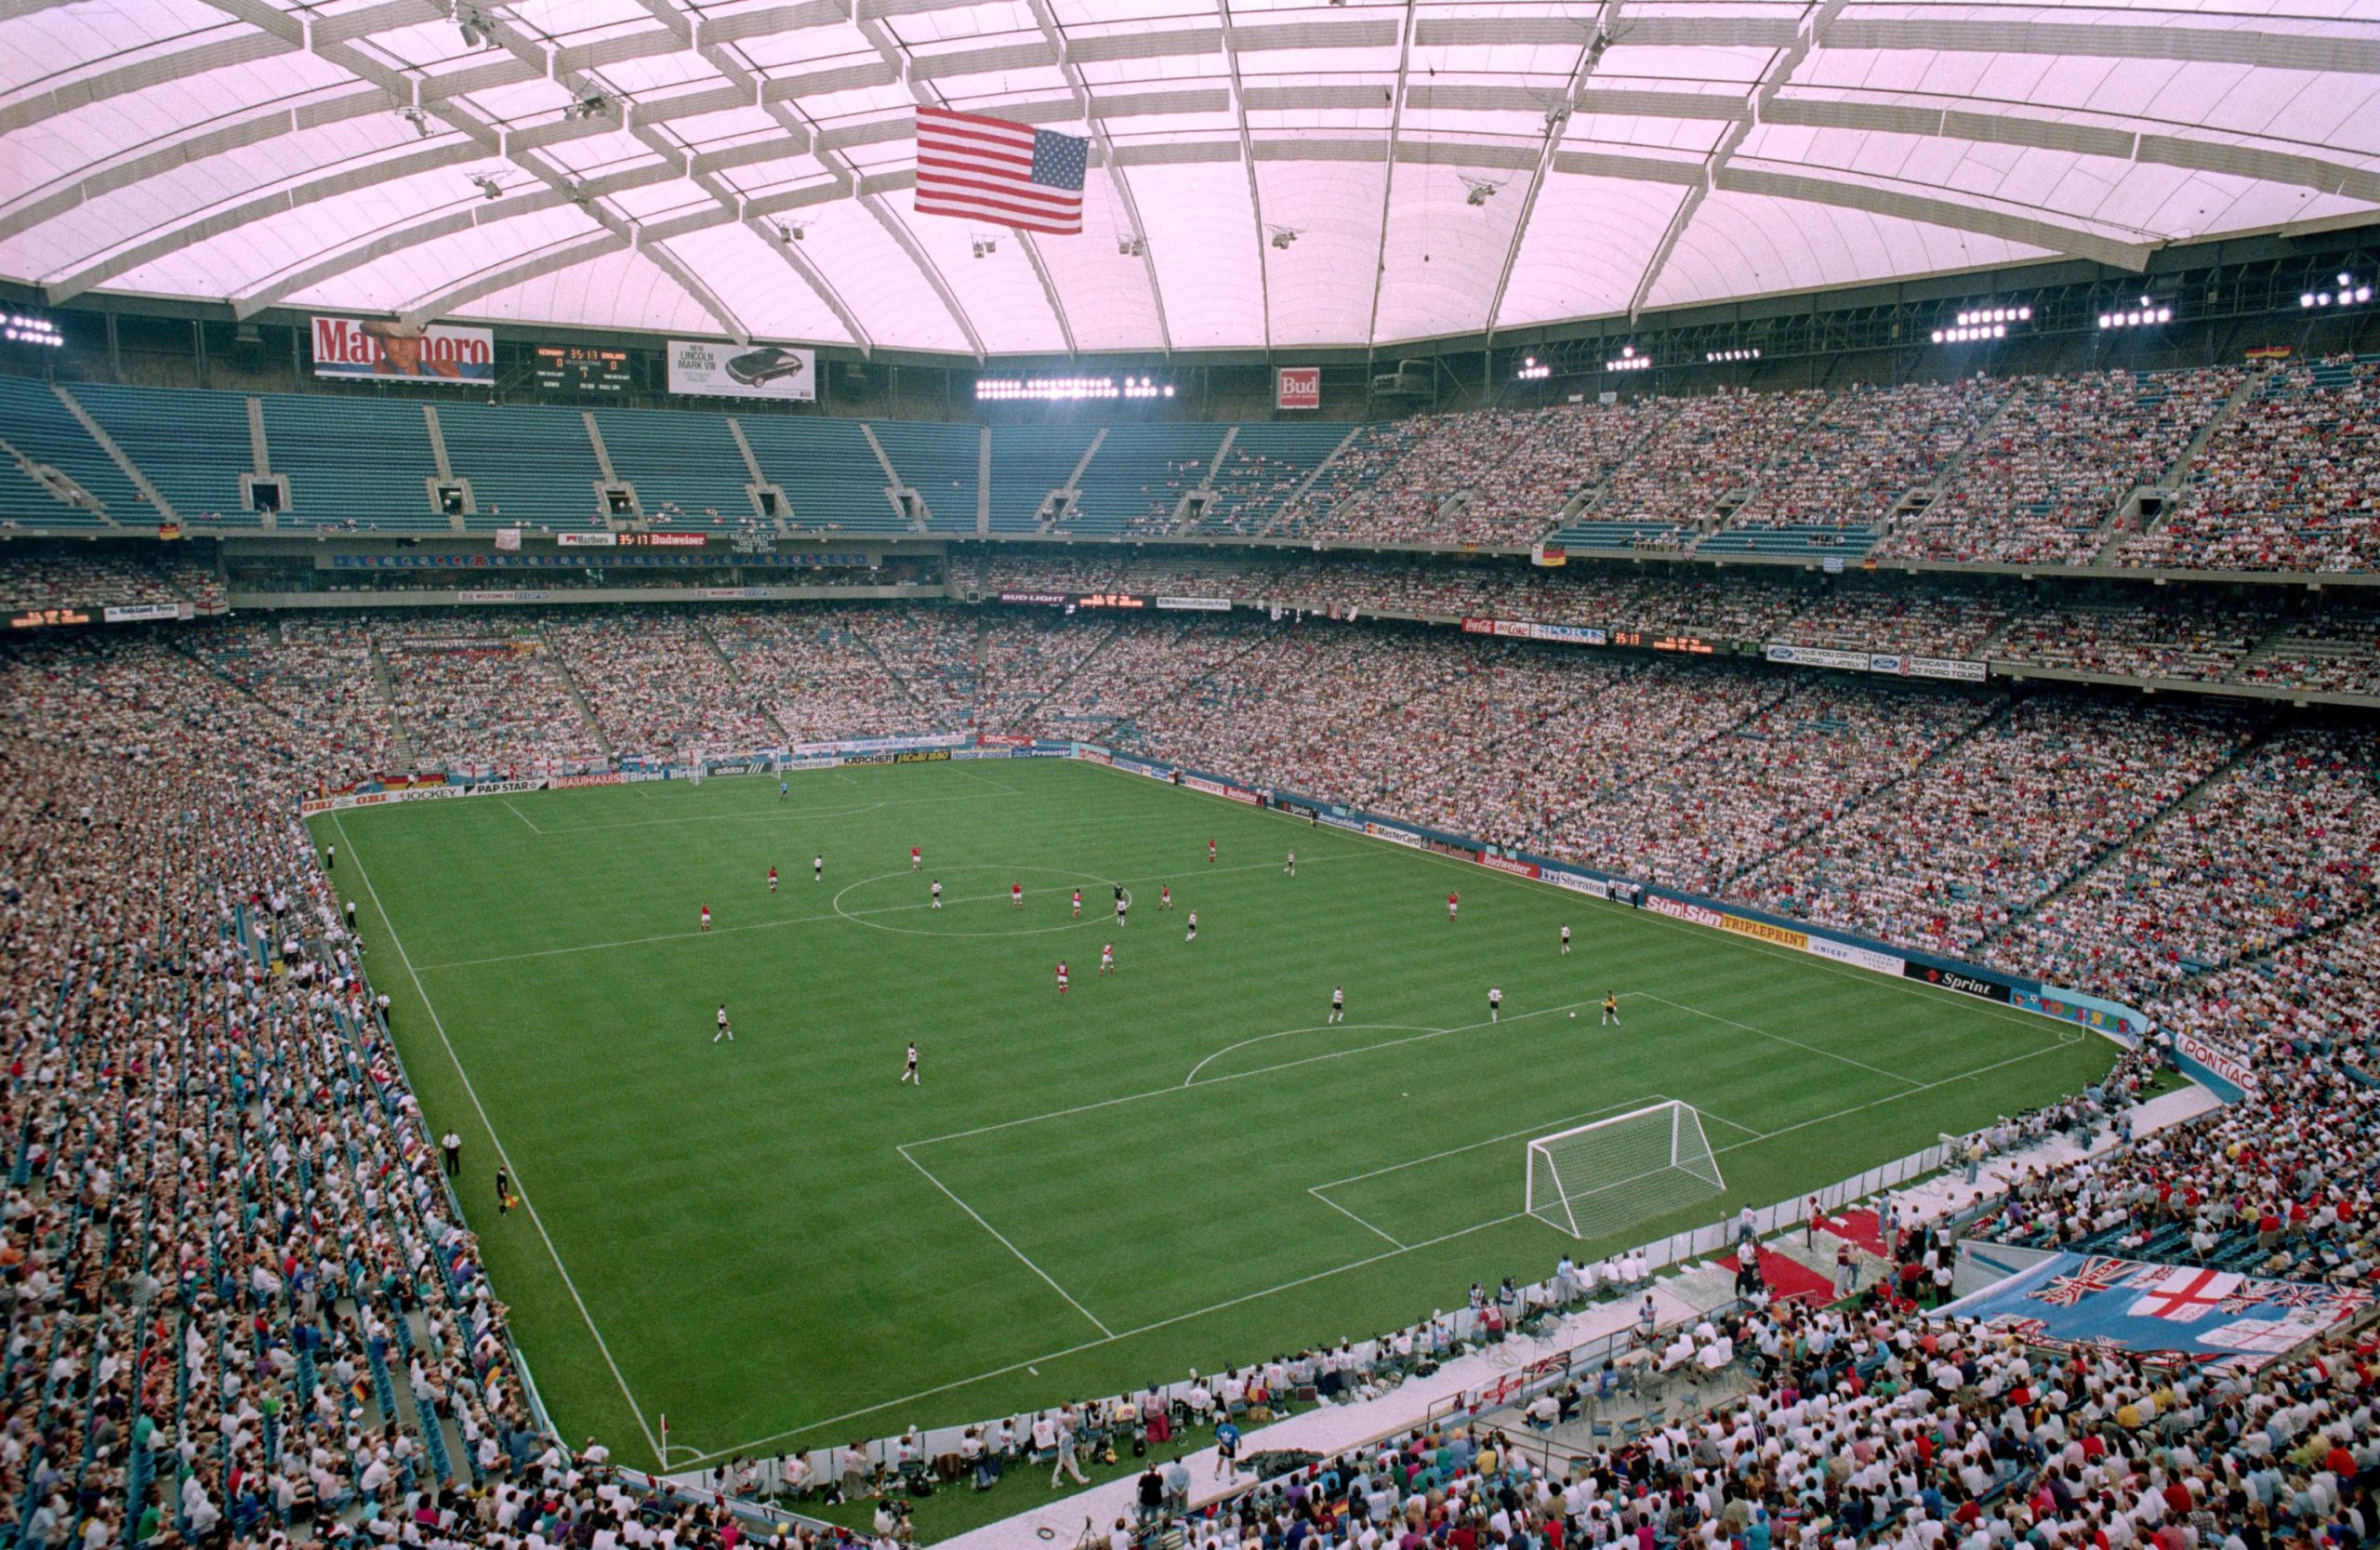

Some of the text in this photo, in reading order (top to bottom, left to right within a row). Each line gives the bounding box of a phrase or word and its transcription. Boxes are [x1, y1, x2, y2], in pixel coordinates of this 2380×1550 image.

[681, 351, 714, 361] LINCOLN
[678, 361, 702, 369] MARK
[1282, 377, 1317, 393] Bud
[619, 535, 648, 545] 35:17
[652, 535, 705, 545] Budweiser
[1508, 623, 1527, 636] Coke
[1538, 625, 1606, 638] SPORTS
[1924, 668, 1949, 676] FORD
[629, 770, 664, 782] Birkel
[715, 766, 745, 775] adidas
[477, 781, 528, 793] PAP STAR
[558, 773, 621, 788] BAUHAUS
[356, 793, 387, 804] OBI
[403, 788, 456, 801] JOCKEY
[1289, 804, 1311, 816] Sprint
[1378, 827, 1420, 845] MasterCard
[1484, 854, 1531, 875] Budweiser
[1561, 876, 1605, 895] Sheraton
[1724, 915, 1807, 947] TRIPLEPRINT
[1814, 944, 1847, 959] UNICEF
[1942, 972, 1991, 995] Sprint
[2104, 1017, 2129, 1033] US
[2185, 1040, 2254, 1090] PONTIAC
